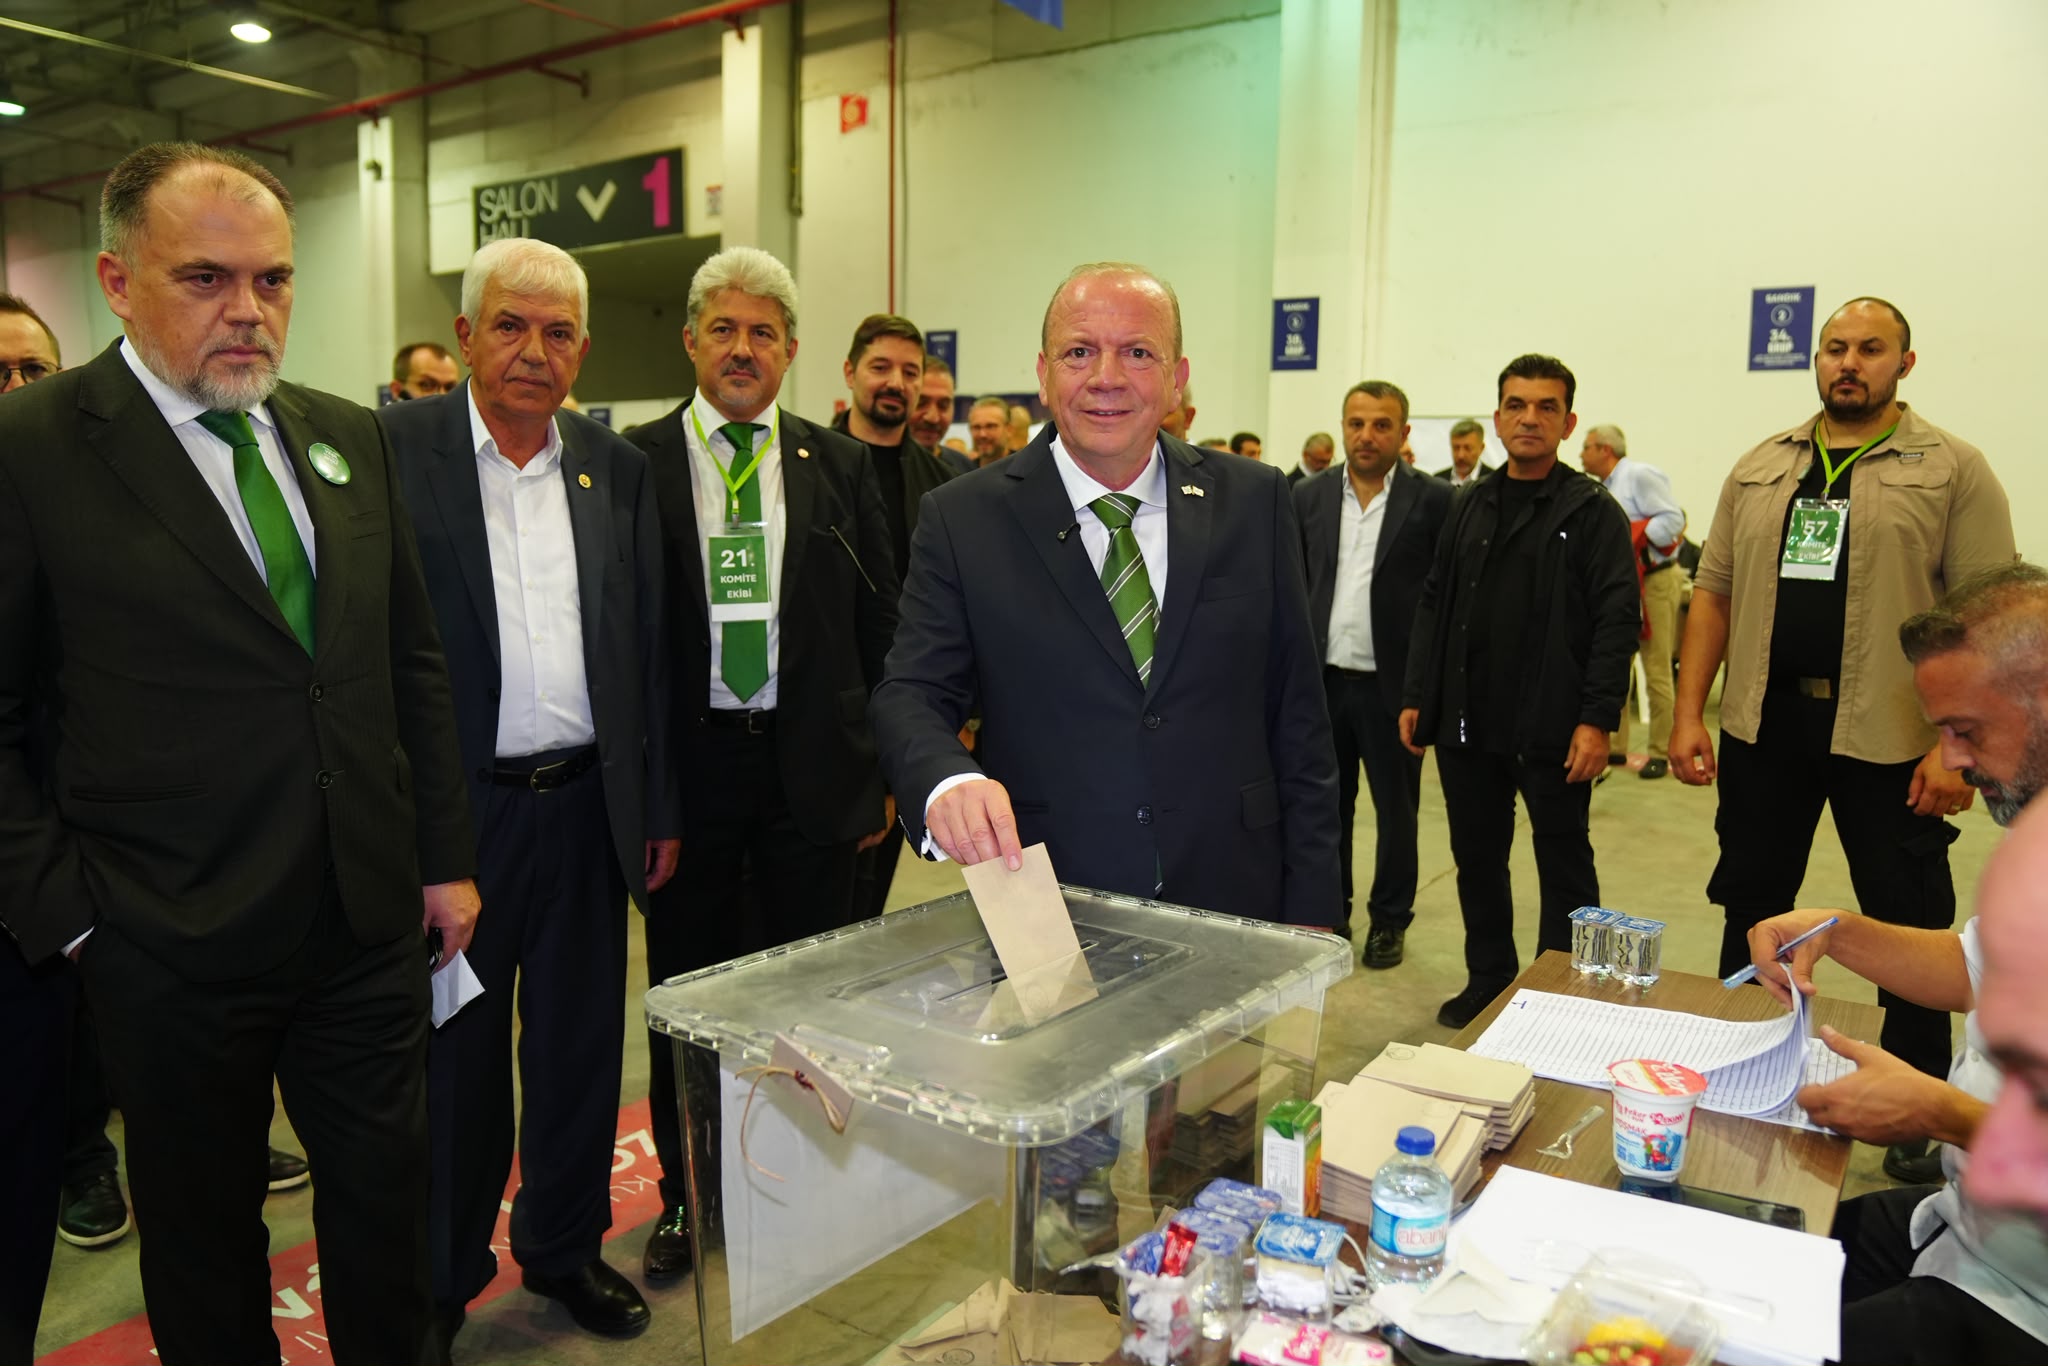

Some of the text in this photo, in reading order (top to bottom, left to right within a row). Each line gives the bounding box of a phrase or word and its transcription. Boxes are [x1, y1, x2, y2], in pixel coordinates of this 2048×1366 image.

[479, 156, 671, 228] SALON 1
[720, 549, 755, 568] 21.
[720, 573, 757, 583] KOMİTE
[726, 587, 752, 598] EKİBİ
